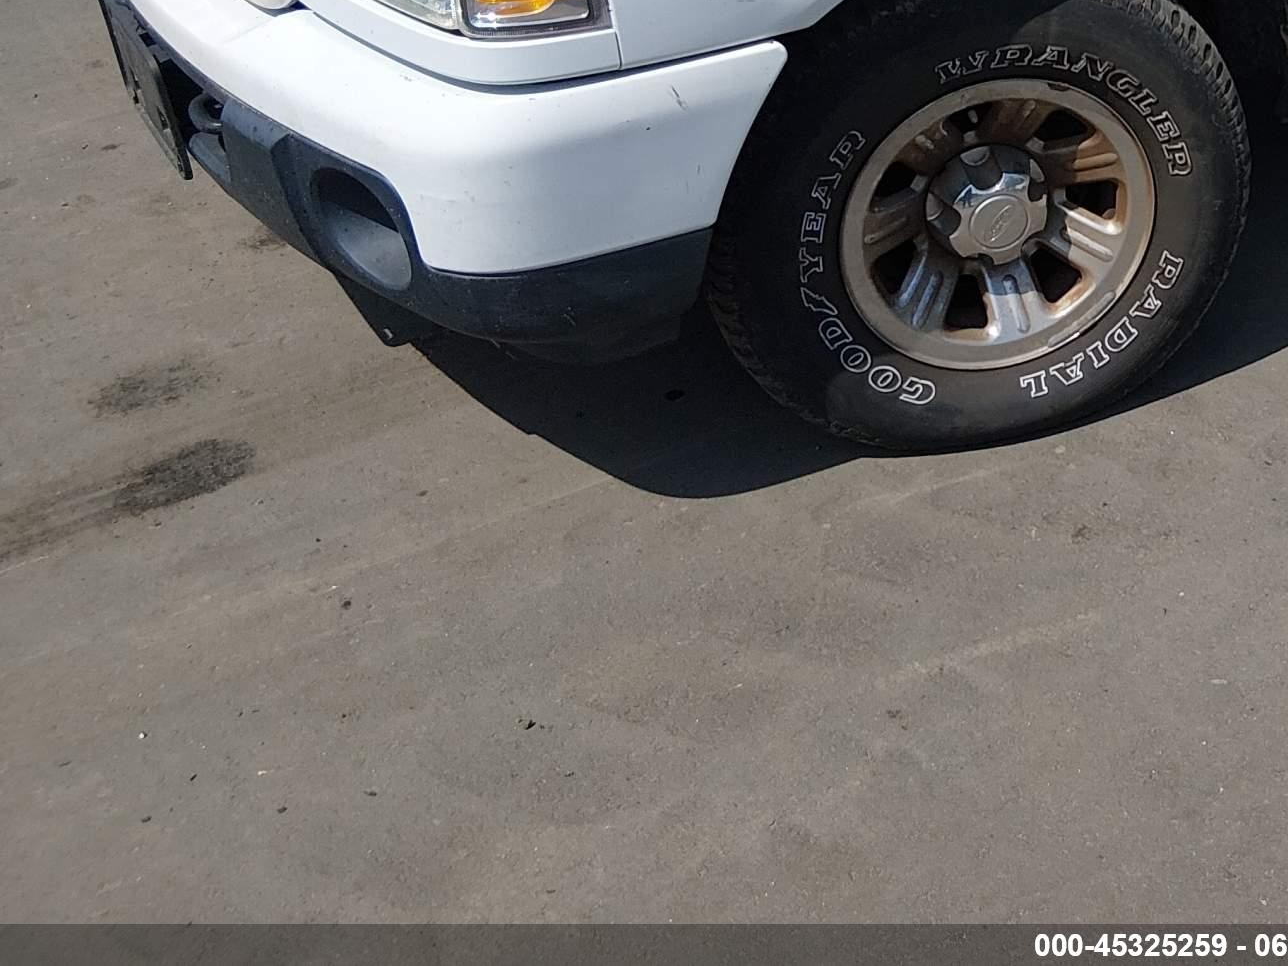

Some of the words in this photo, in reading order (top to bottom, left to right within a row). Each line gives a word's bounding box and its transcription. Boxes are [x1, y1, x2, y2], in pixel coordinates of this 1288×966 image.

[935, 42, 1195, 177] WRANGLER
[795, 129, 938, 406] GOODYEAR
[1019, 249, 1186, 399] RADIAL
